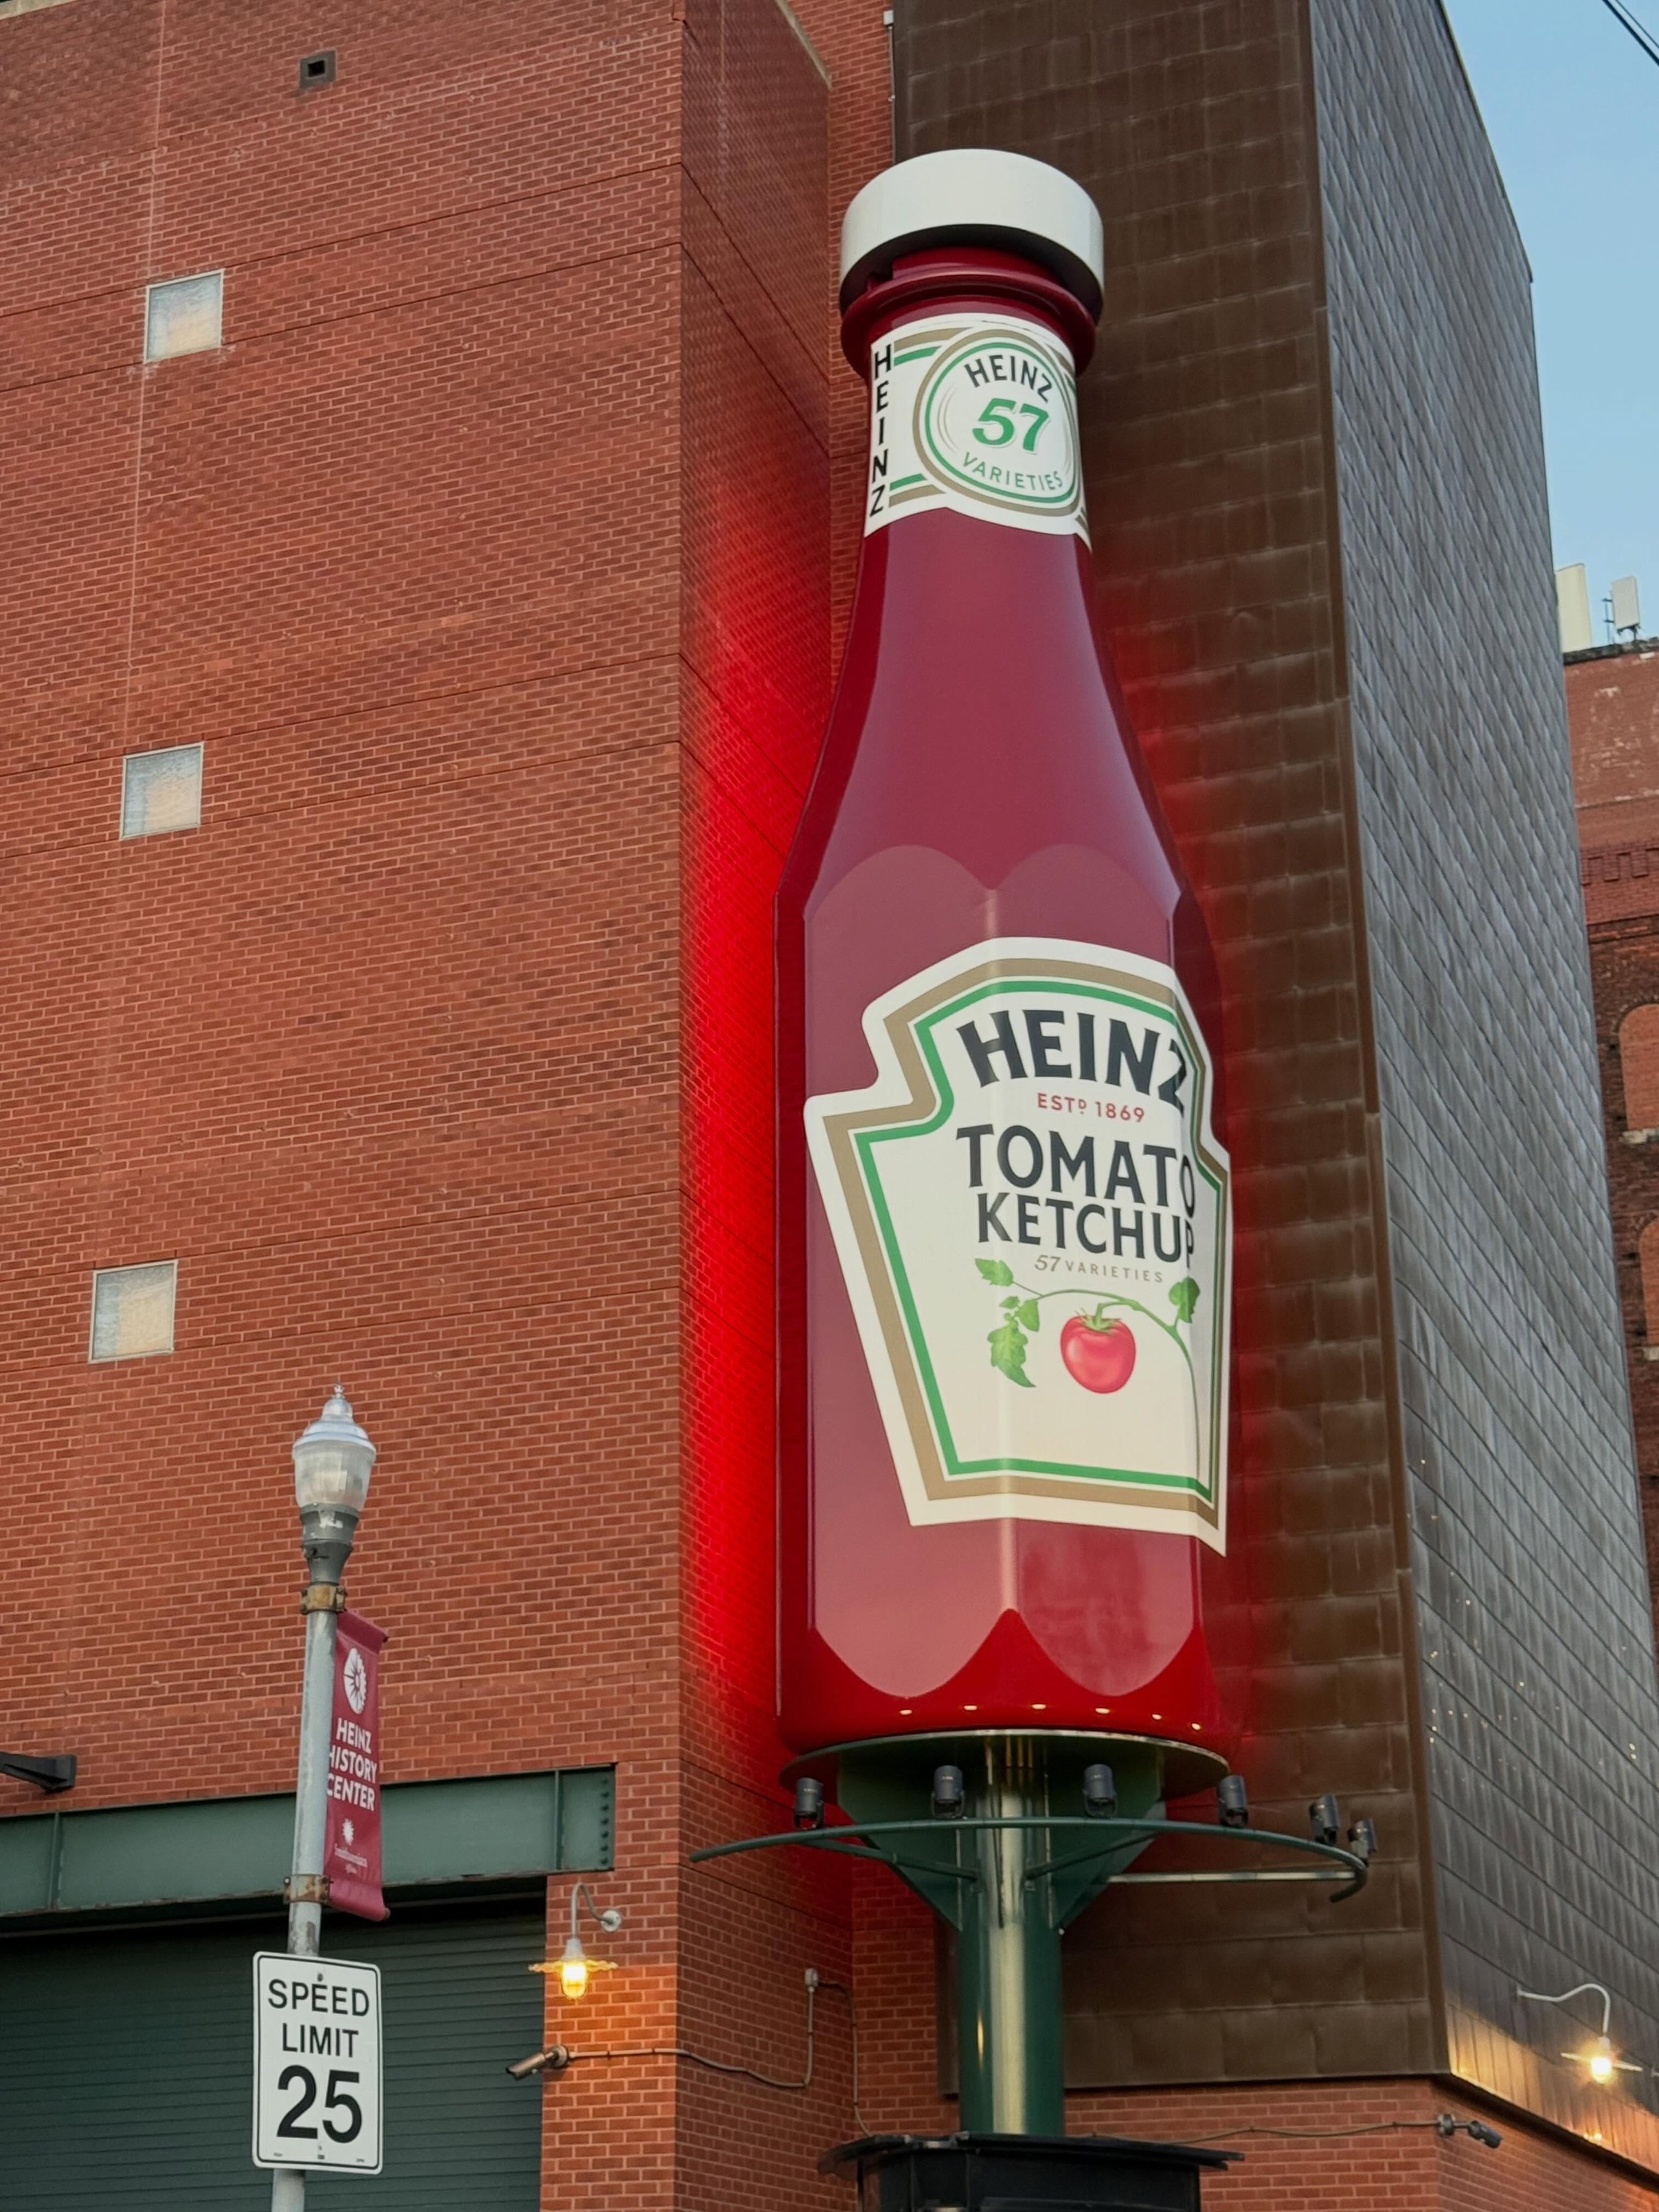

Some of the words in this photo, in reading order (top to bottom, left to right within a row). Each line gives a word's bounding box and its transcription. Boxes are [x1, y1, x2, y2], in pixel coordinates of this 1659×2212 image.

[964, 354, 1053, 403] HEINZ
[869, 344, 892, 518] HEINZ
[972, 398, 1050, 453] 57
[963, 451, 1063, 492] VARIETIES
[956, 1009, 1187, 1119] HEINZ
[1095, 1101, 1145, 1123] 1869
[956, 1124, 1195, 1219] TOMATO
[977, 1192, 1194, 1269] KETCHUP
[1034, 1254, 1061, 1272] 57
[1065, 1260, 1163, 1283] VARIETIES
[336, 1717, 372, 1754] HEINZ
[329, 1744, 378, 1784] HISTORY
[327, 1773, 376, 1811] CENTER
[267, 1978, 370, 2017] SPEED
[282, 2022, 359, 2058] LIMIT
[276, 2064, 363, 2144] 25
